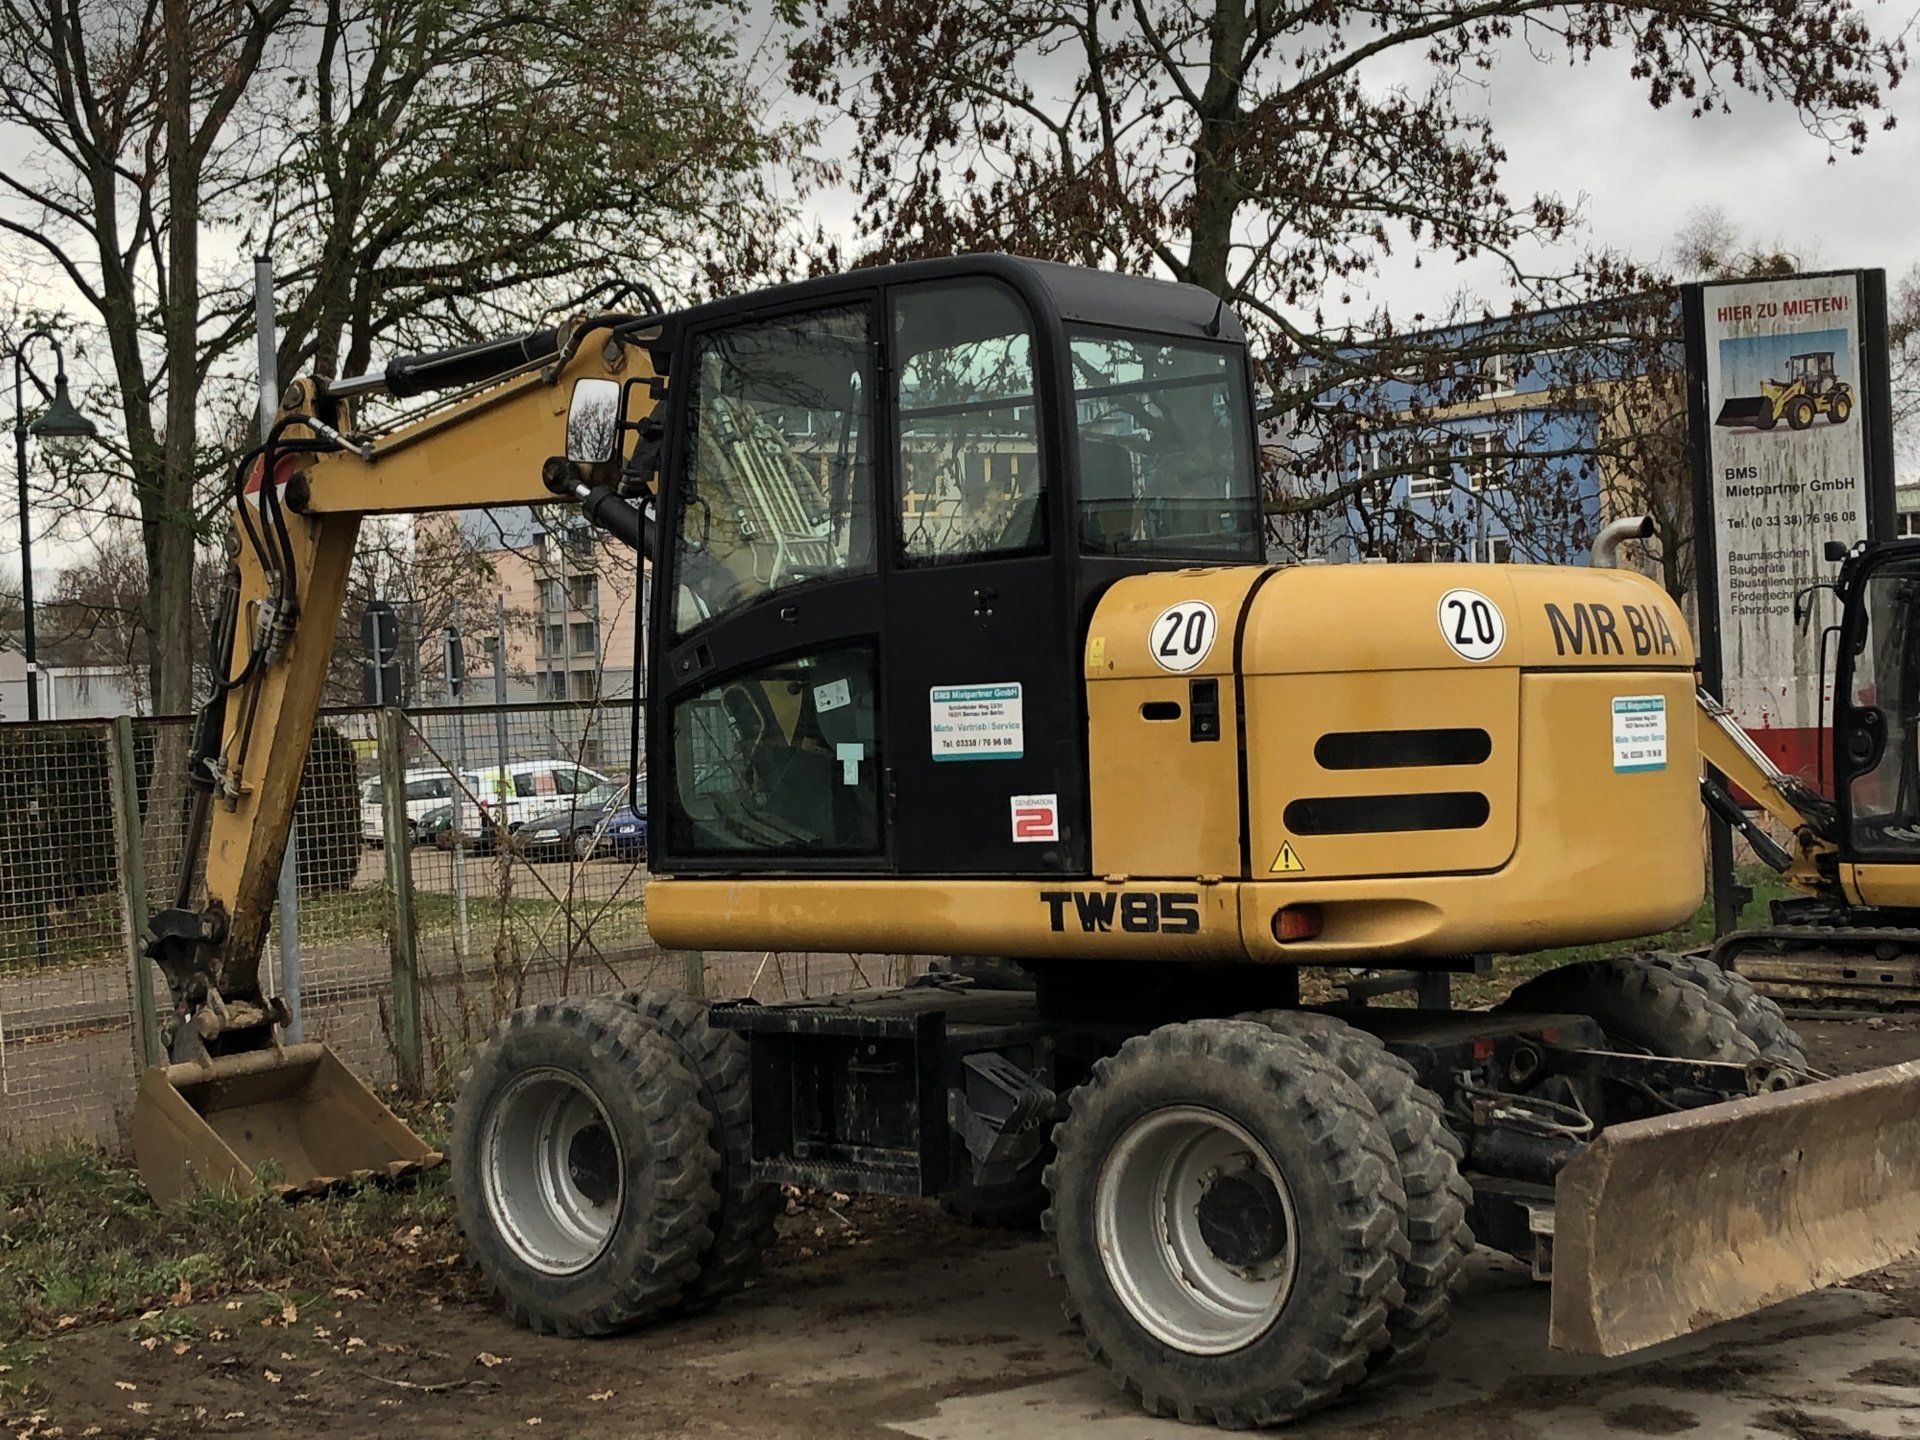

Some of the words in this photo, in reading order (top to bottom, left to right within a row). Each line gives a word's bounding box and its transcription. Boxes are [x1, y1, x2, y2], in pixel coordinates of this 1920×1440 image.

[1717, 305, 1752, 322] HIER
[1756, 303, 1778, 318] ZU
[1783, 296, 1849, 316] MIETEN!
[1725, 467, 1758, 480] BMS
[1726, 483, 1806, 498] Mietpartner
[1810, 477, 1855, 492] GmbH
[1727, 518, 1748, 529] Tel.
[1751, 516, 1763, 530] (0
[1766, 515, 1780, 527] 33
[1783, 514, 1802, 527] 38)
[1806, 513, 1820, 524] 76
[1823, 512, 1839, 523] 96
[1841, 511, 1856, 522] 08
[1728, 549, 1810, 561] Baumaschinen
[1729, 563, 1786, 576] Baugeräte
[1731, 605, 1790, 616] Fahrzeuge
[1448, 600, 1495, 645] 20
[1544, 603, 1624, 656] MR
[1622, 604, 1677, 656] BIA
[1160, 610, 1206, 656] 20
[934, 691, 951, 700] BMS
[952, 690, 993, 700] Mietpartner
[994, 687, 1018, 697] GmbH
[934, 724, 953, 732] Miete
[957, 723, 986, 732] Vertrieb
[991, 722, 1020, 730] Service
[943, 739, 954, 748] Tel.
[1003, 737, 1013, 745] 08
[1015, 798, 1054, 806] GENERATION
[1016, 808, 1054, 837] 2
[1040, 892, 1200, 934] TW85
